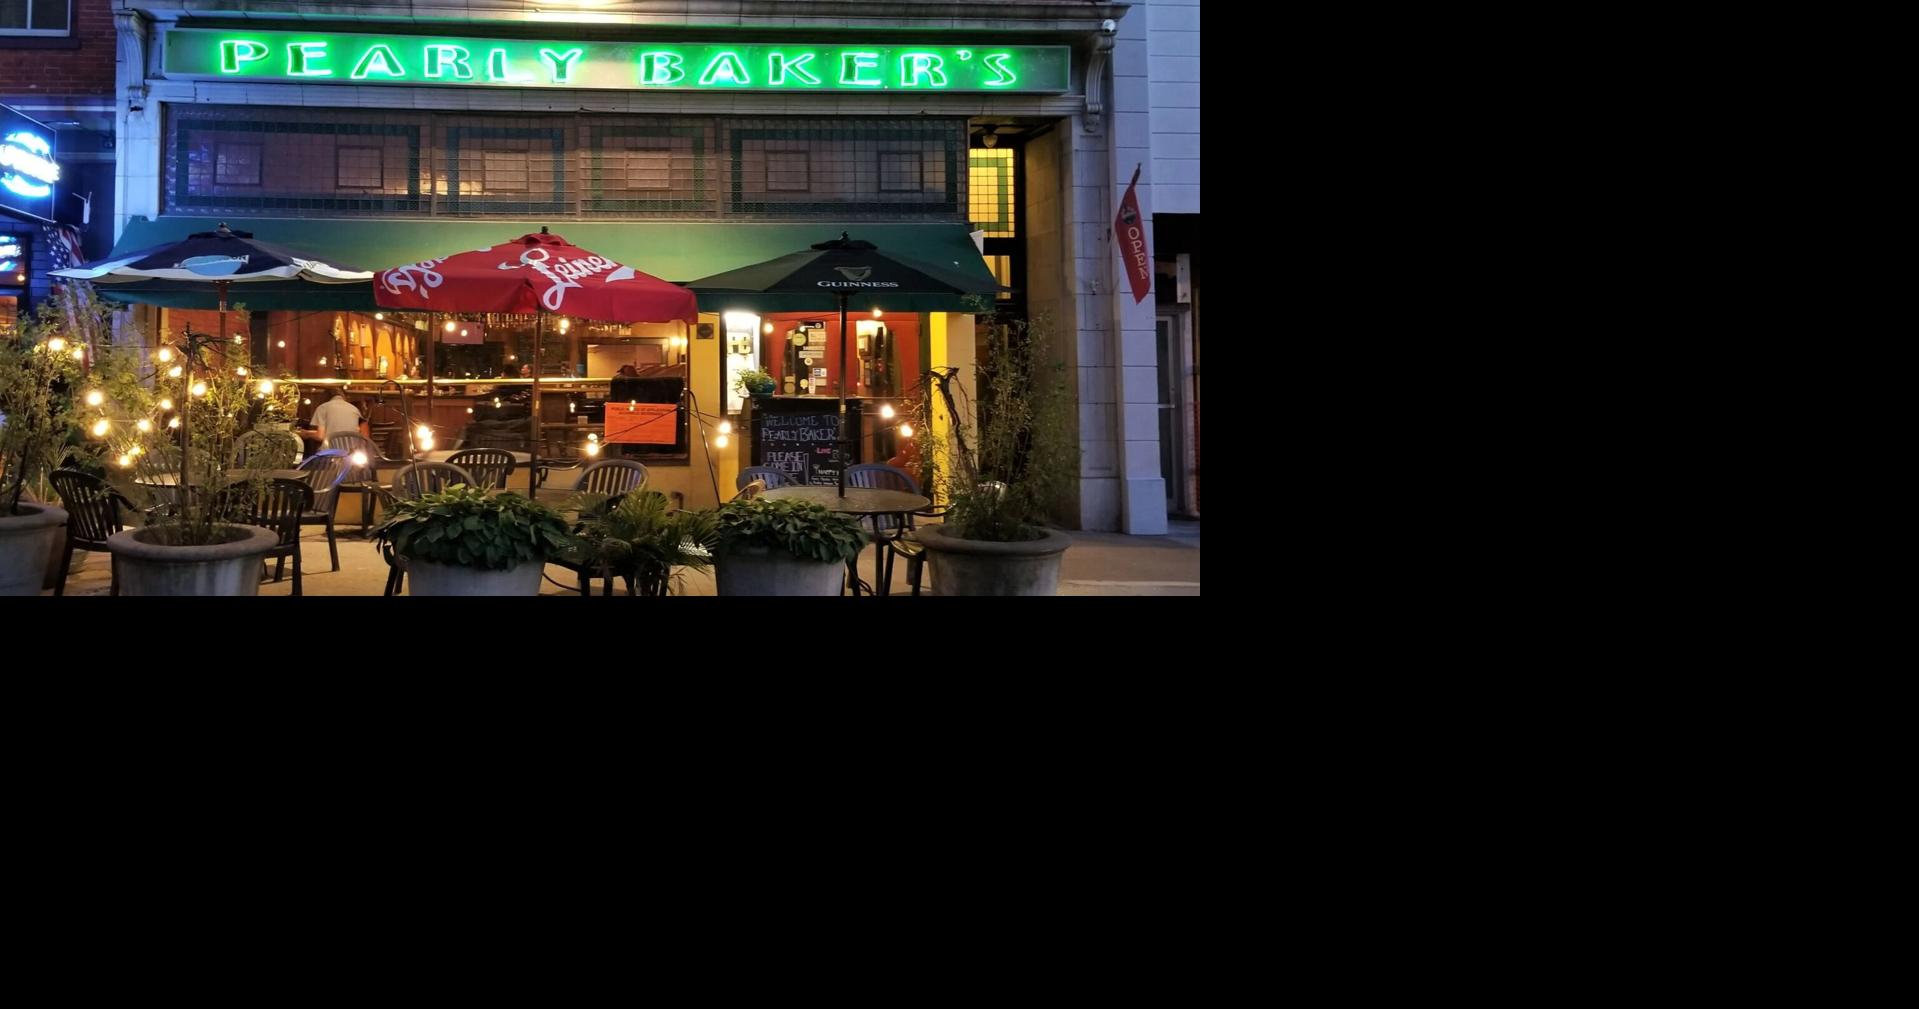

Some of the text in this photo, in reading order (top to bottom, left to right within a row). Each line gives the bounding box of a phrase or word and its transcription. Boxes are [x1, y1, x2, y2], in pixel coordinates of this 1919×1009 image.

[219, 39, 1018, 87] PEARLY BAKER'S
[1127, 226, 1149, 280] OPEN
[816, 280, 899, 288] GUINNESS
[765, 414, 840, 427] WELCOME TO
[767, 451, 803, 462] PLEASE
